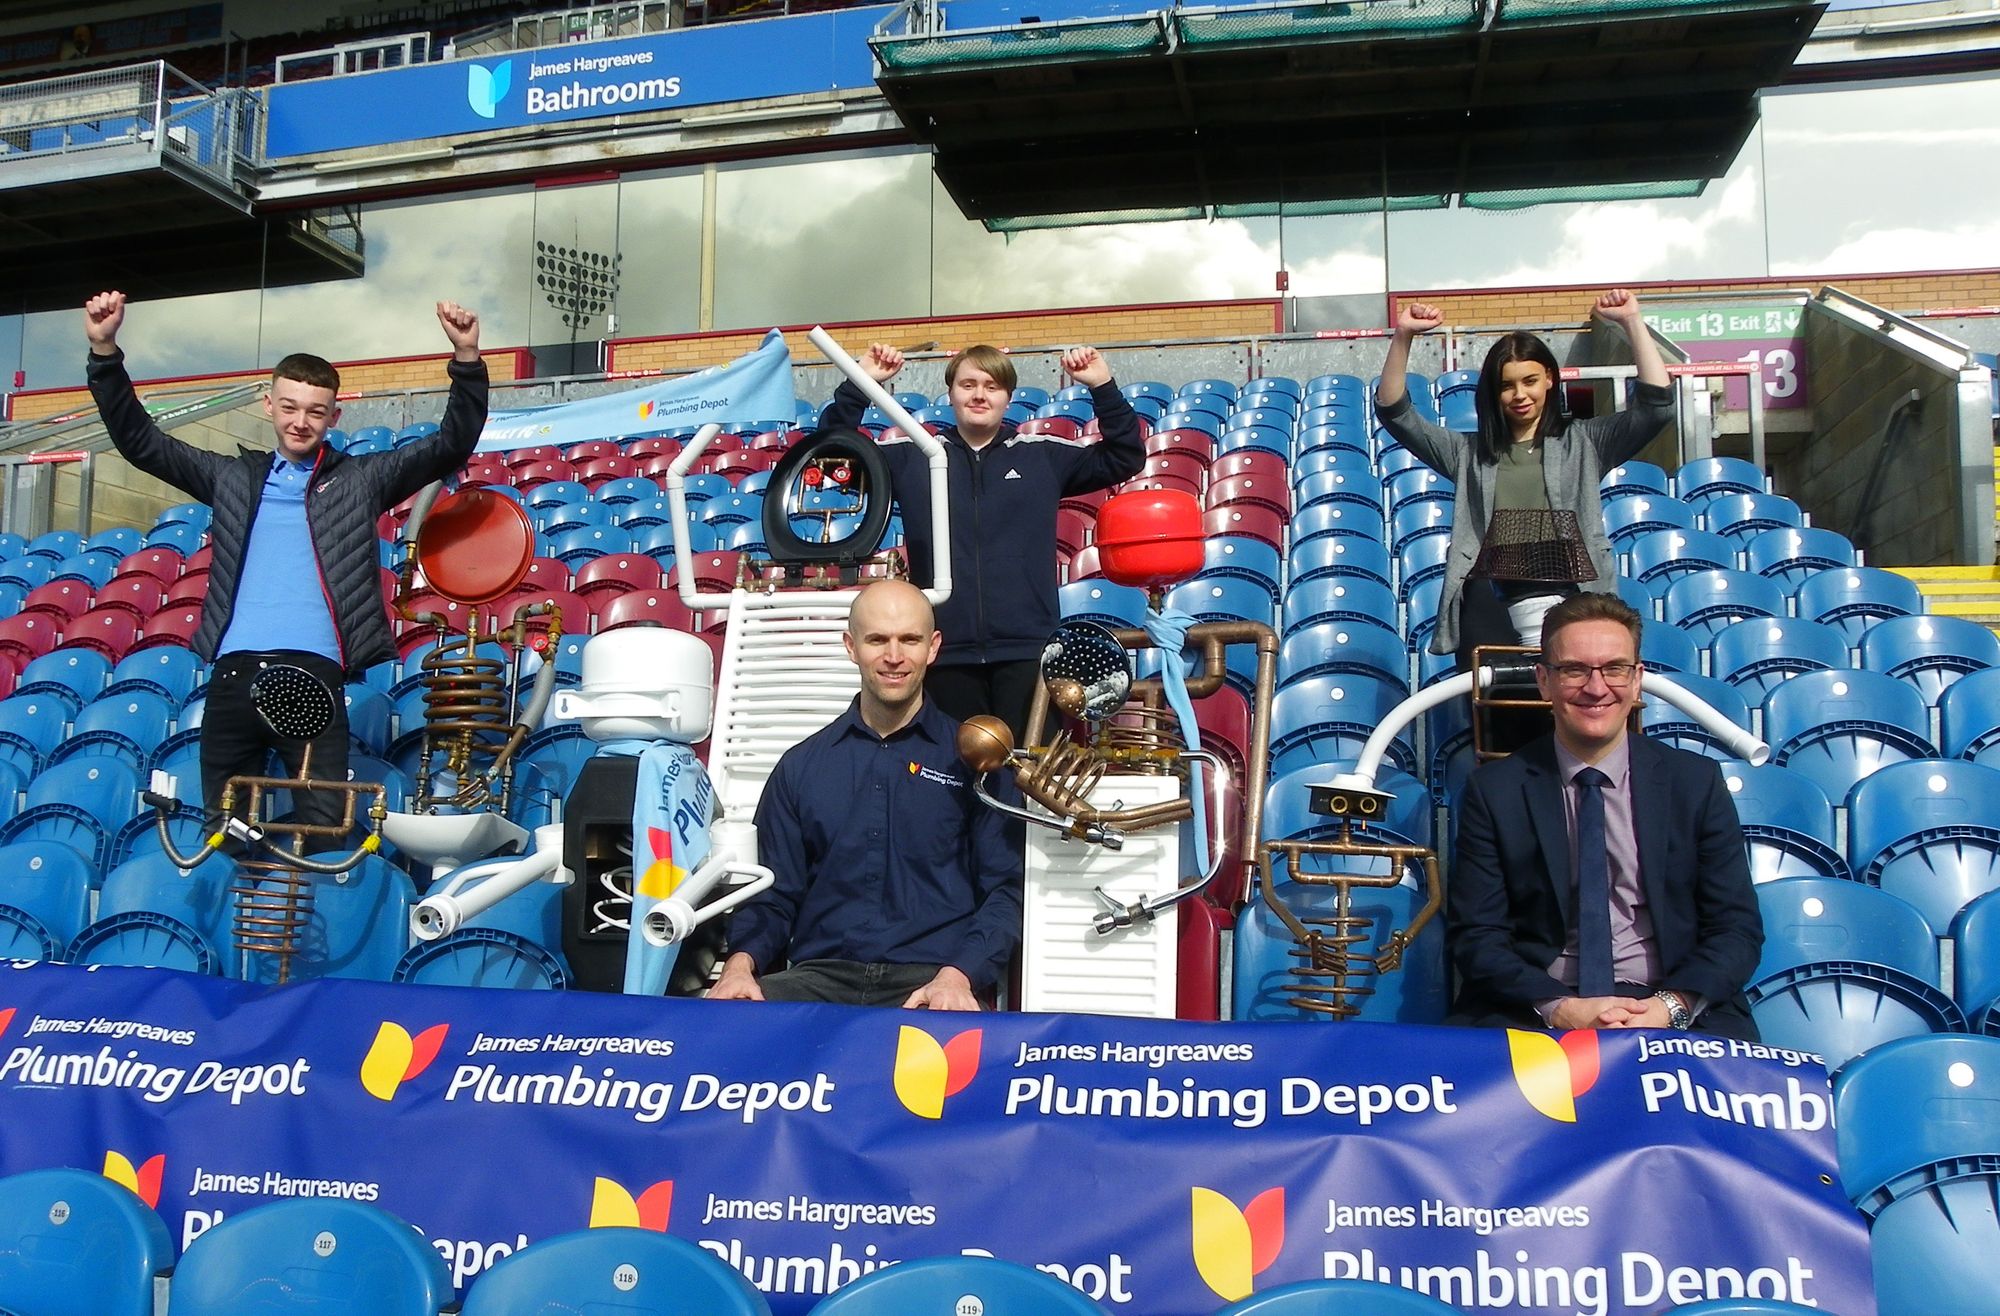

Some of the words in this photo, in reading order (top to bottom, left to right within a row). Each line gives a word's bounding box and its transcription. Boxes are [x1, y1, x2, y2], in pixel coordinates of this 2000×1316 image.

[529, 62, 571, 81] James
[574, 51, 653, 73] Hargreaves
[527, 76, 681, 114] Bathrooms
[1662, 317, 1692, 334] Exit
[1695, 313, 1724, 337] 13
[1729, 314, 1760, 332] Exit
[1737, 349, 1797, 398] 3
[657, 402, 699, 417] Plumbing
[700, 397, 729, 410] Depot
[658, 758, 681, 812] James
[920, 771, 947, 785] Plumbing
[946, 778, 964, 788] Depot
[23, 1015, 85, 1038] James
[83, 1017, 196, 1046] Hargreaves
[467, 1033, 540, 1057] James
[541, 1034, 674, 1057] Hargreaves
[1014, 1042, 1097, 1068] James
[1102, 1042, 1253, 1068] Hargreaves
[1638, 1036, 1725, 1063] James
[0, 1046, 186, 1103] Plumbing
[183, 1058, 311, 1105] Depot
[445, 1065, 674, 1122] Plumbing
[680, 1073, 835, 1124] Depot
[1005, 1075, 1266, 1128] Plumbing
[1280, 1075, 1458, 1124] Depot
[189, 1167, 260, 1196] James
[263, 1171, 379, 1201] Hargreaves
[702, 1193, 783, 1225] James
[788, 1195, 936, 1231] Hargreaves
[1324, 1199, 1416, 1234] James
[1421, 1199, 1590, 1236] Hargreaves
[319, 1240, 331, 1249] 117
[618, 1272, 633, 1284] 118
[961, 1305, 977, 1315] 119
